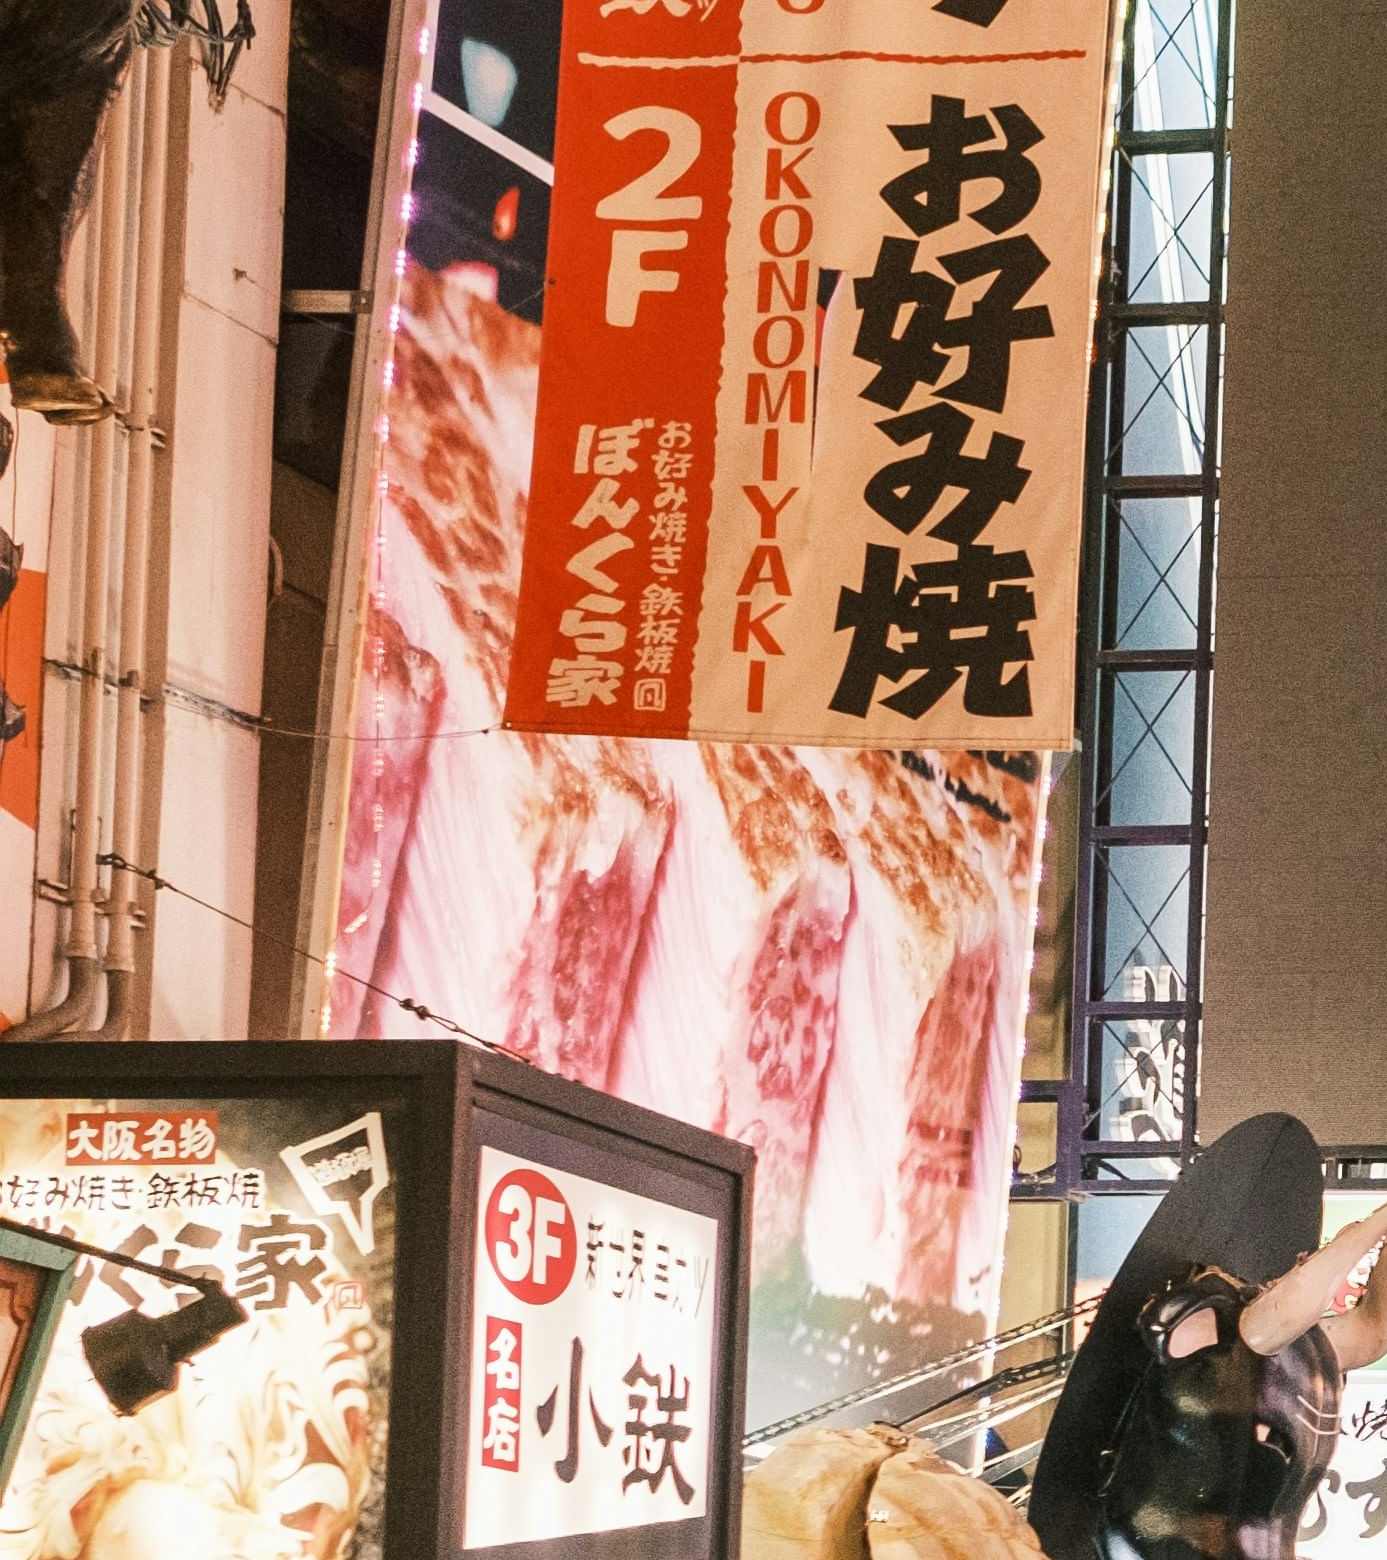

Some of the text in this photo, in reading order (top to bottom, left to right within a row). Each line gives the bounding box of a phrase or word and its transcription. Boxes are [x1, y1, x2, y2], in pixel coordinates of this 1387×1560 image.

[595, 105, 703, 328] 2F
[732, 91, 822, 714] OKONOMIYAKI
[828, 94, 1056, 720] お好み焼
[545, 418, 655, 708] ぼんくら家
[66, 1118, 217, 1161] 大阪名物
[494, 1182, 570, 1285] 3F
[483, 1322, 521, 1462] 名店
